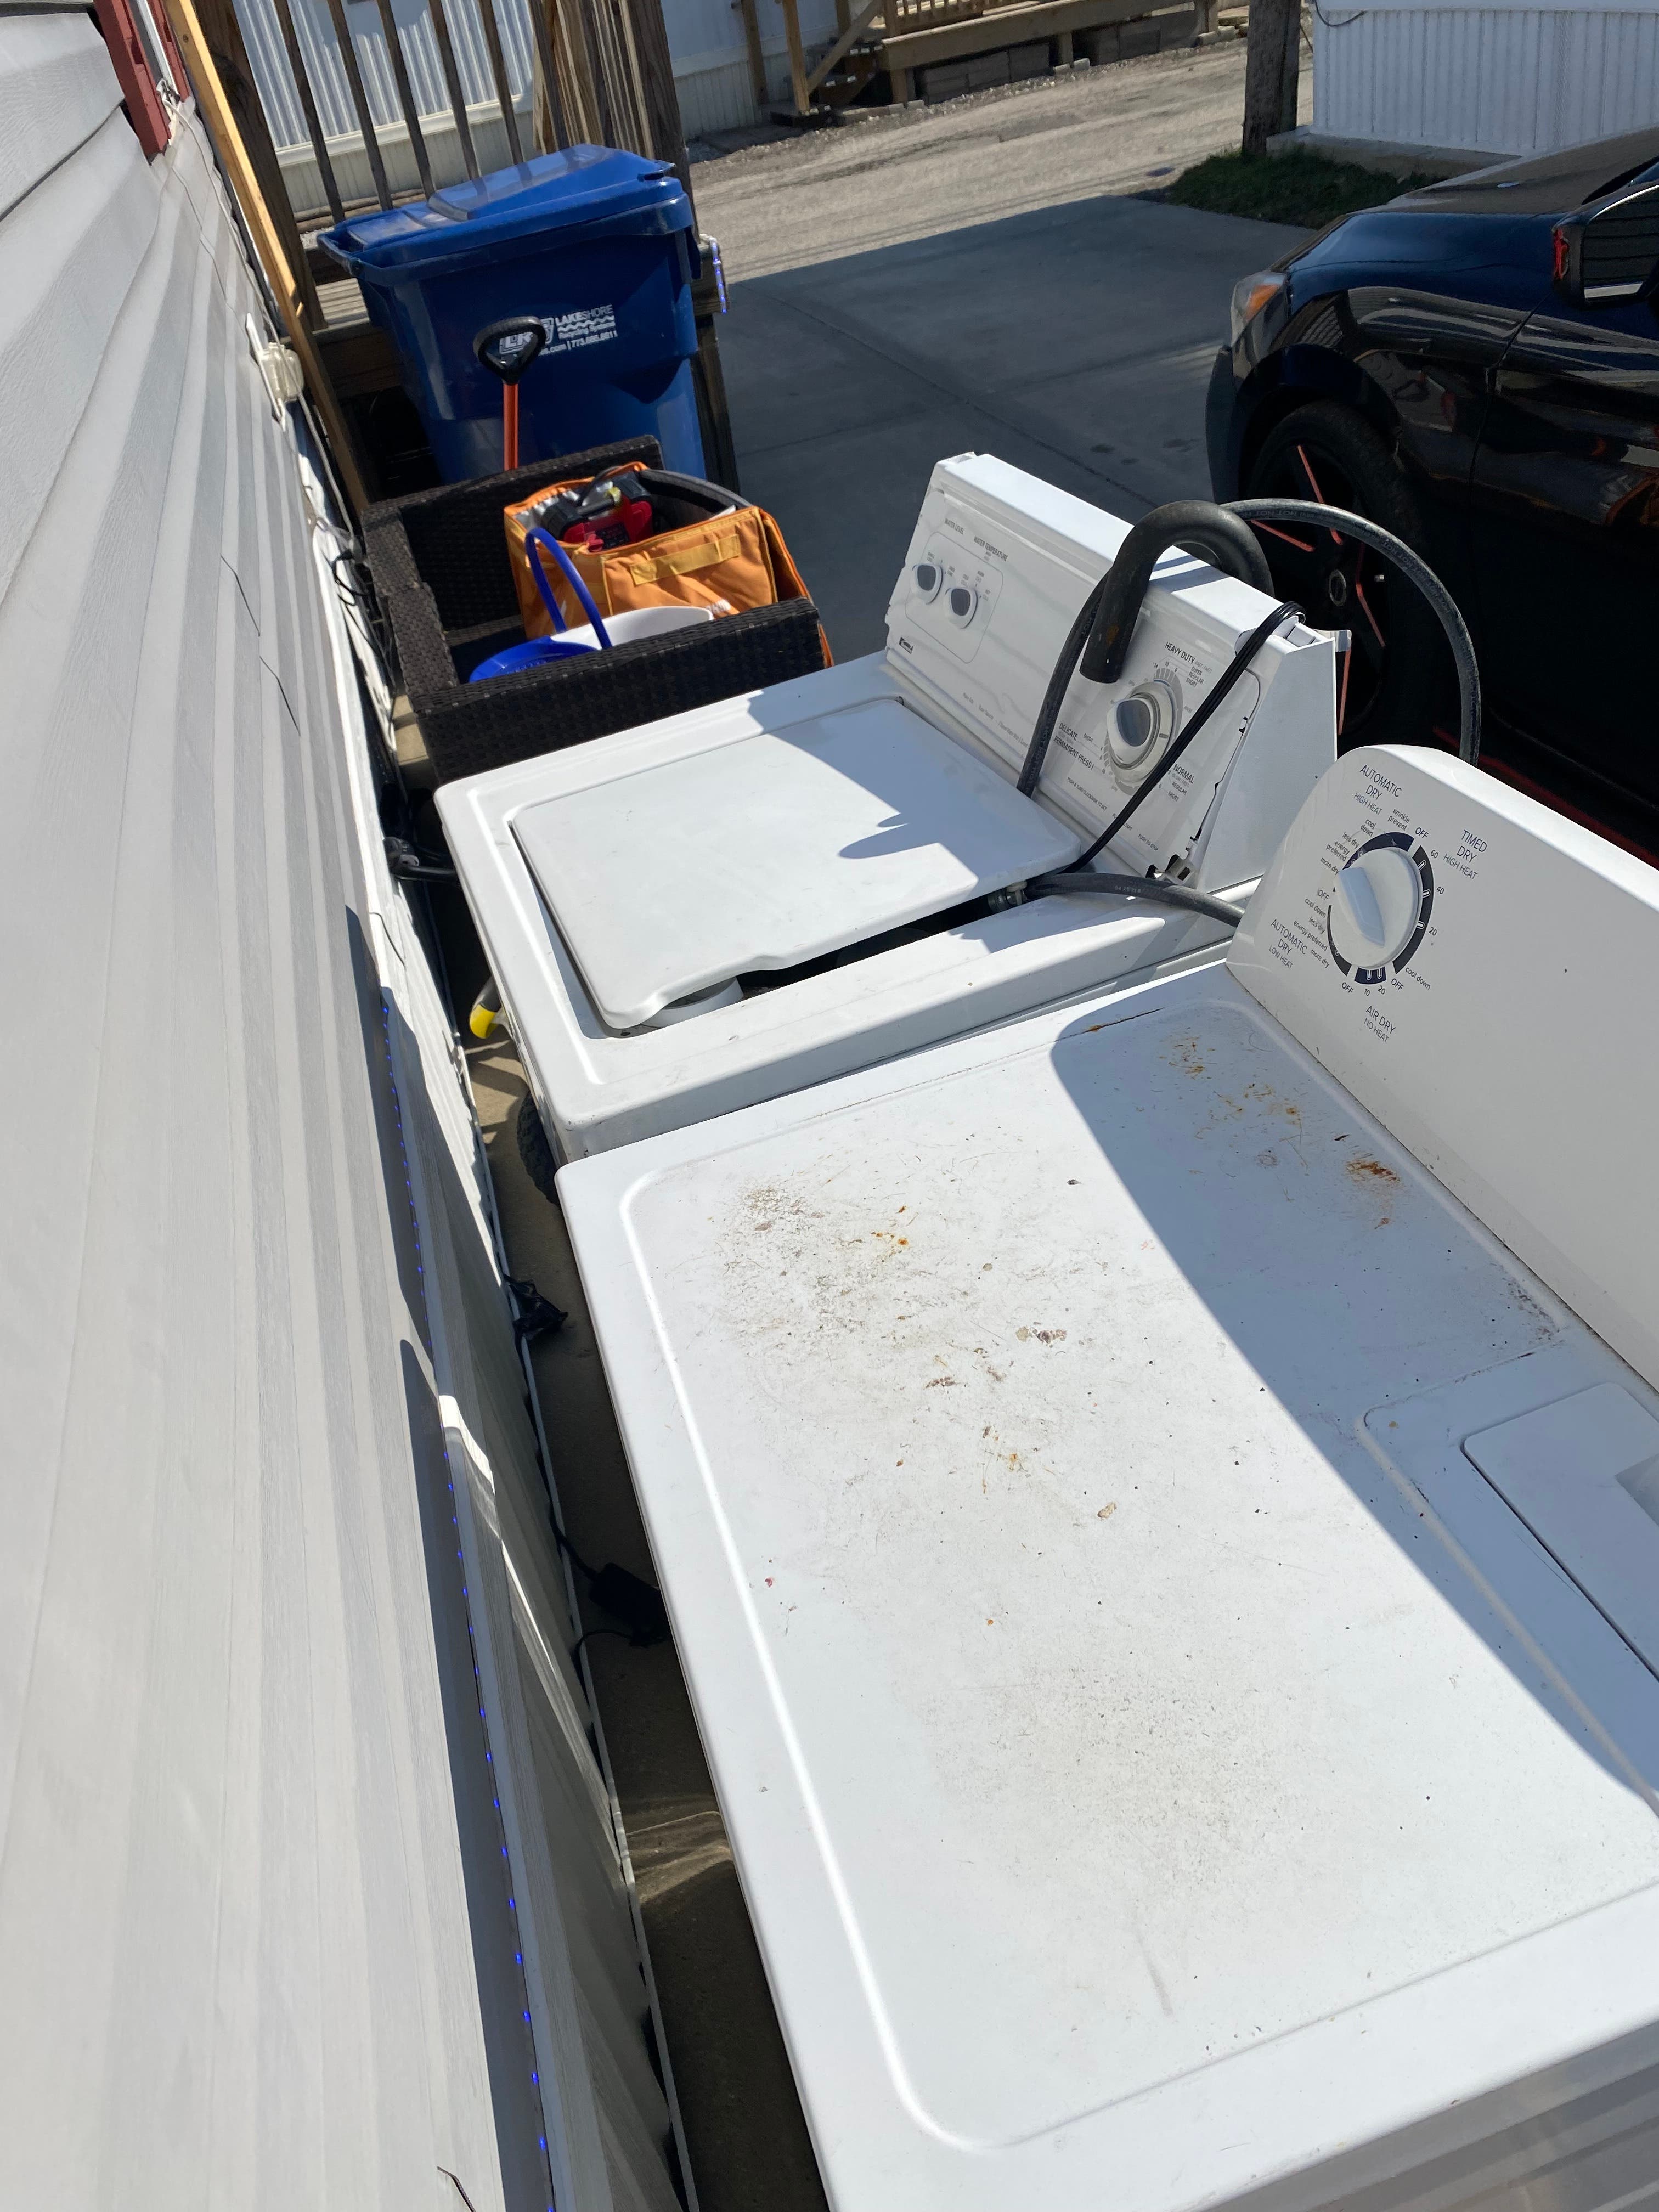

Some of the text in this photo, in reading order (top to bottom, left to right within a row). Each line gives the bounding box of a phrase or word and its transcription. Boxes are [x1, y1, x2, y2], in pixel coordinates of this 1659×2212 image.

[555, 304, 614, 326] LAKESHORE
[945, 518, 965, 535] WATER LEVEL
[974, 535, 986, 548] WATER
[985, 543, 1008, 562] TEMPERATURE
[1165, 642, 1181, 655] HEAVY
[1181, 651, 1196, 664] DUTY
[1188, 672, 1204, 684] REGULAR
[1191, 666, 1202, 676] SUPER
[1186, 678, 1198, 687] SHORT
[1059, 723, 1078, 741] DELICATE
[1054, 735, 1079, 758] PERMANENT
[1078, 754, 1092, 769] PRESS
[1173, 764, 1194, 784] NORMAL
[1360, 765, 1402, 797] AUTOMATIC
[1168, 791, 1180, 802] SHORT
[1172, 781, 1188, 795] REGULAR
[1366, 785, 1383, 800] DRY
[1354, 792, 1383, 815] HIGH HEAT
[1365, 819, 1376, 830] cool
[1387, 815, 1407, 831] prevent
[1393, 808, 1410, 823] wrinkle
[1342, 831, 1359, 849] less dry
[1360, 825, 1373, 837] down
[1415, 827, 1429, 839] OFF
[1334, 841, 1350, 856] energy
[1461, 830, 1487, 853] TIMED
[1325, 844, 1347, 862] preferred
[1430, 849, 1438, 859] 60
[1457, 845, 1477, 863] DRY
[1320, 857, 1340, 876] more dry
[1443, 853, 1478, 880] HIGH HEAT
[1317, 889, 1330, 900] OFF
[1436, 886, 1444, 895] 40
[1305, 898, 1326, 918] cool down
[1308, 916, 1325, 934] less dry
[1429, 927, 1437, 936] 20
[1271, 919, 1307, 955] AUTOMATIC
[1294, 921, 1328, 952] energy preferred
[1278, 939, 1293, 955] DRY
[1269, 945, 1293, 969] LOW HEAT
[1310, 949, 1330, 968] more dry
[1341, 981, 1354, 994] OFF
[1391, 978, 1404, 991] OFF
[1405, 967, 1431, 991] cool down
[1364, 988, 1370, 996] 10
[1378, 985, 1386, 995] 20
[1365, 1006, 1396, 1034] AIR DRY
[1364, 1018, 1390, 1043] NO HEAT
